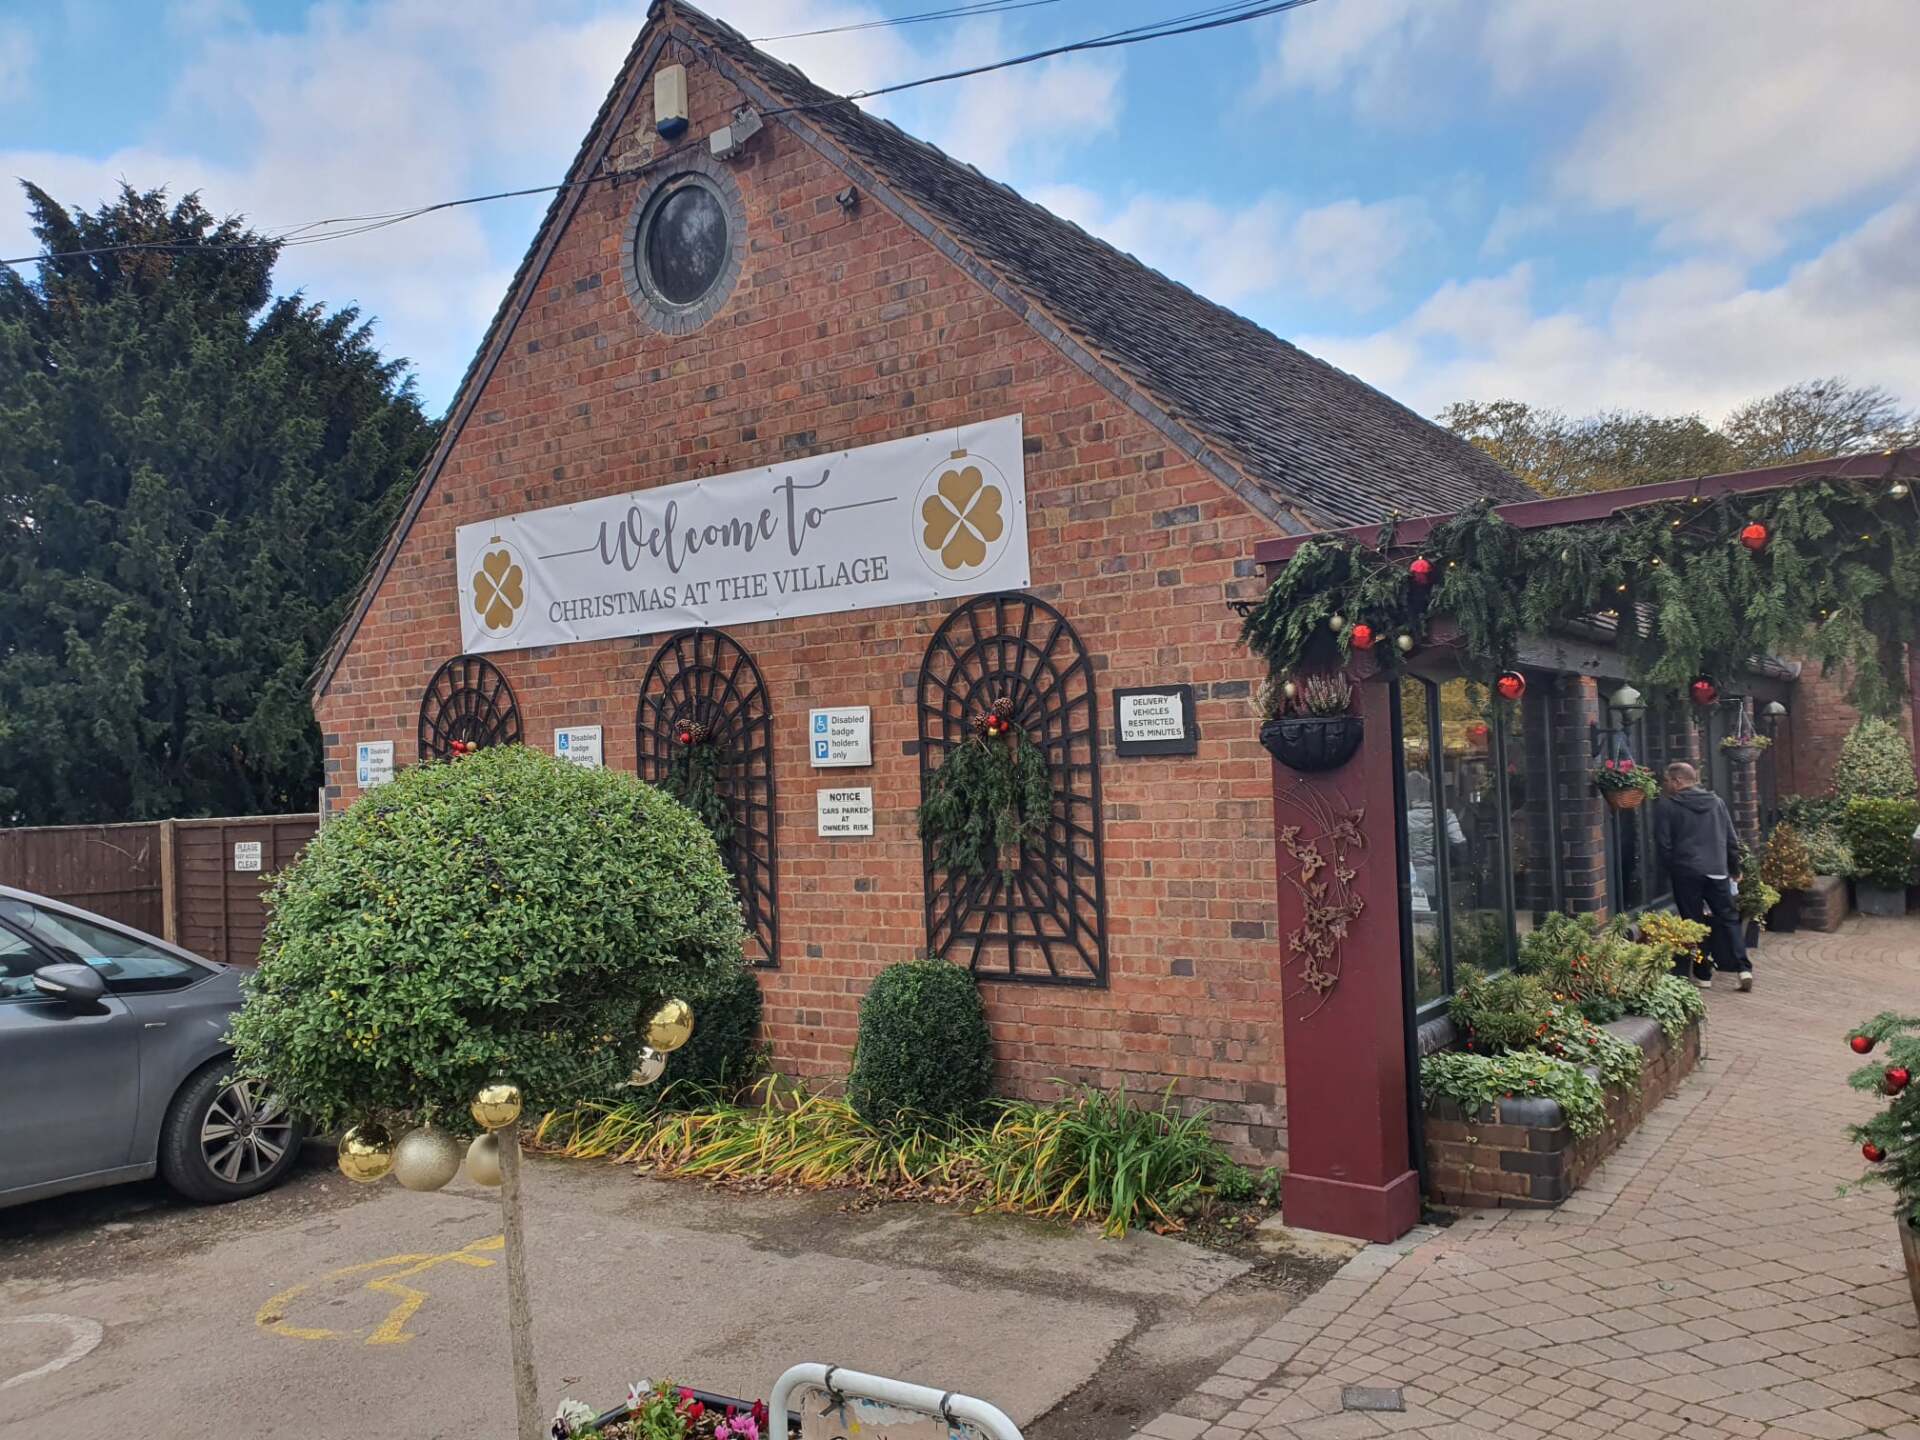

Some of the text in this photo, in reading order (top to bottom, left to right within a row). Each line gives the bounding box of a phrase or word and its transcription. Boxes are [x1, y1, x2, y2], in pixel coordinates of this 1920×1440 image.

[597, 500, 779, 574] Welcome
[549, 555, 889, 623] CHRISTMAS AT THE VILLAGE
[1132, 697, 1169, 706] DELIVERY
[1132, 707, 1170, 716] VEHICLES
[831, 714, 865, 725] Disabled
[1128, 718, 1175, 727] RESTRICTED
[831, 727, 855, 737] badge
[1124, 727, 1182, 738] TO 15 MINUTES
[831, 738, 860, 747] holders
[832, 750, 848, 761] only
[829, 792, 861, 801] NOTICE
[853, 823, 869, 831] RISK
[237, 861, 258, 869] CLEAR
